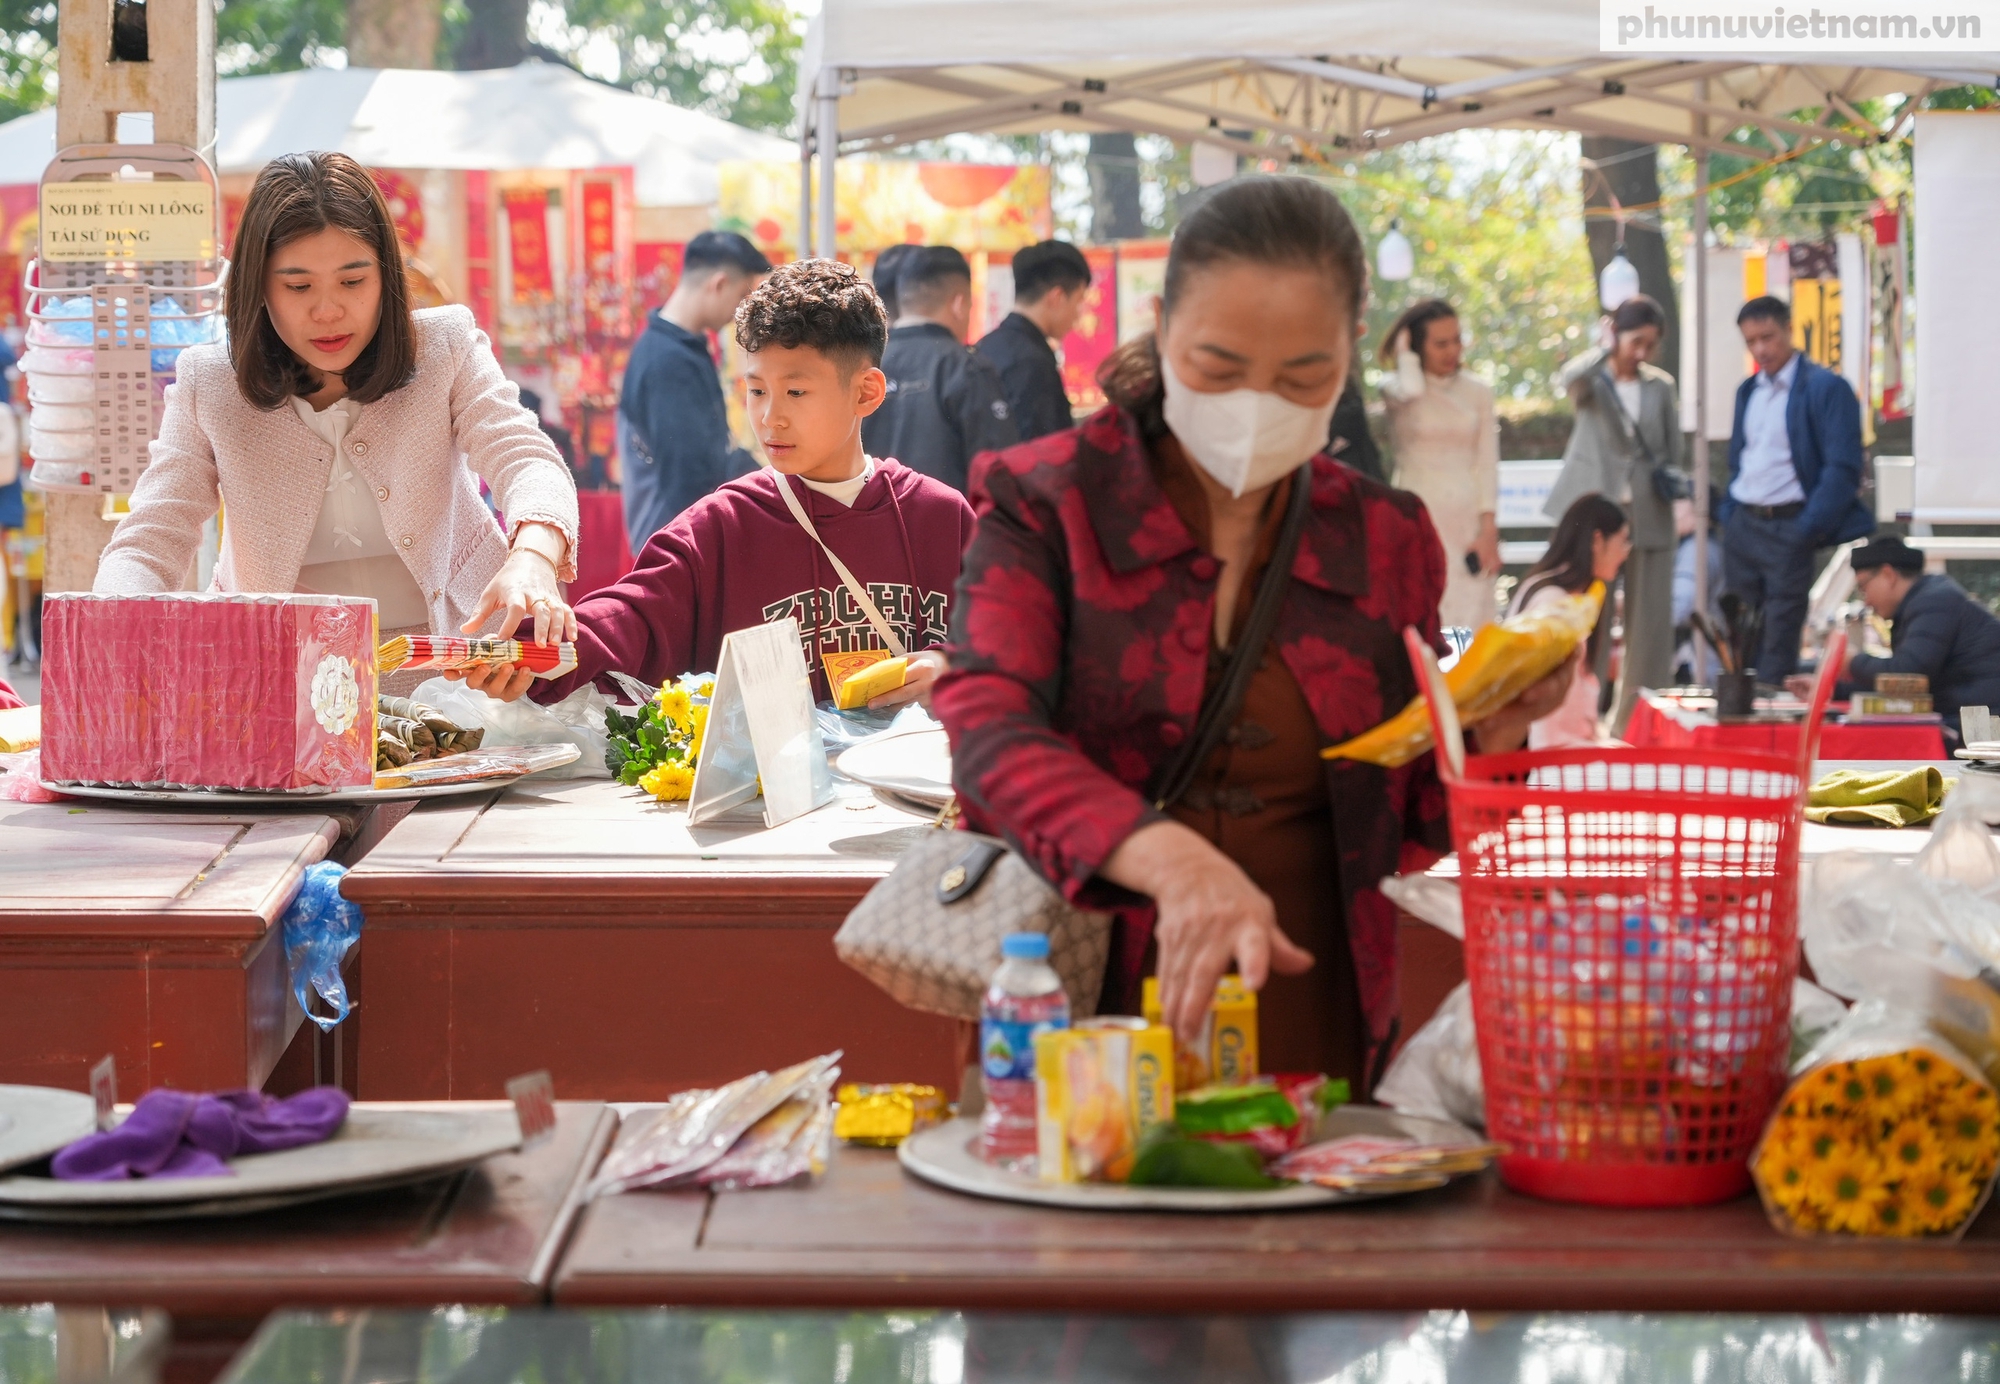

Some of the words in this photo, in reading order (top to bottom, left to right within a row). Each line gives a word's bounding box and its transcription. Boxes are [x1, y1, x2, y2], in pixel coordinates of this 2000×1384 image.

[49, 203, 77, 216] NƠI
[106, 201, 134, 216] TÚI
[138, 203, 155, 216] NI
[159, 200, 204, 216] LÔNG
[49, 227, 76, 242] TÁI
[105, 230, 151, 244] DỤNG
[762, 582, 948, 636] ZBCHM
[1135, 1052, 1161, 1128] Cust
